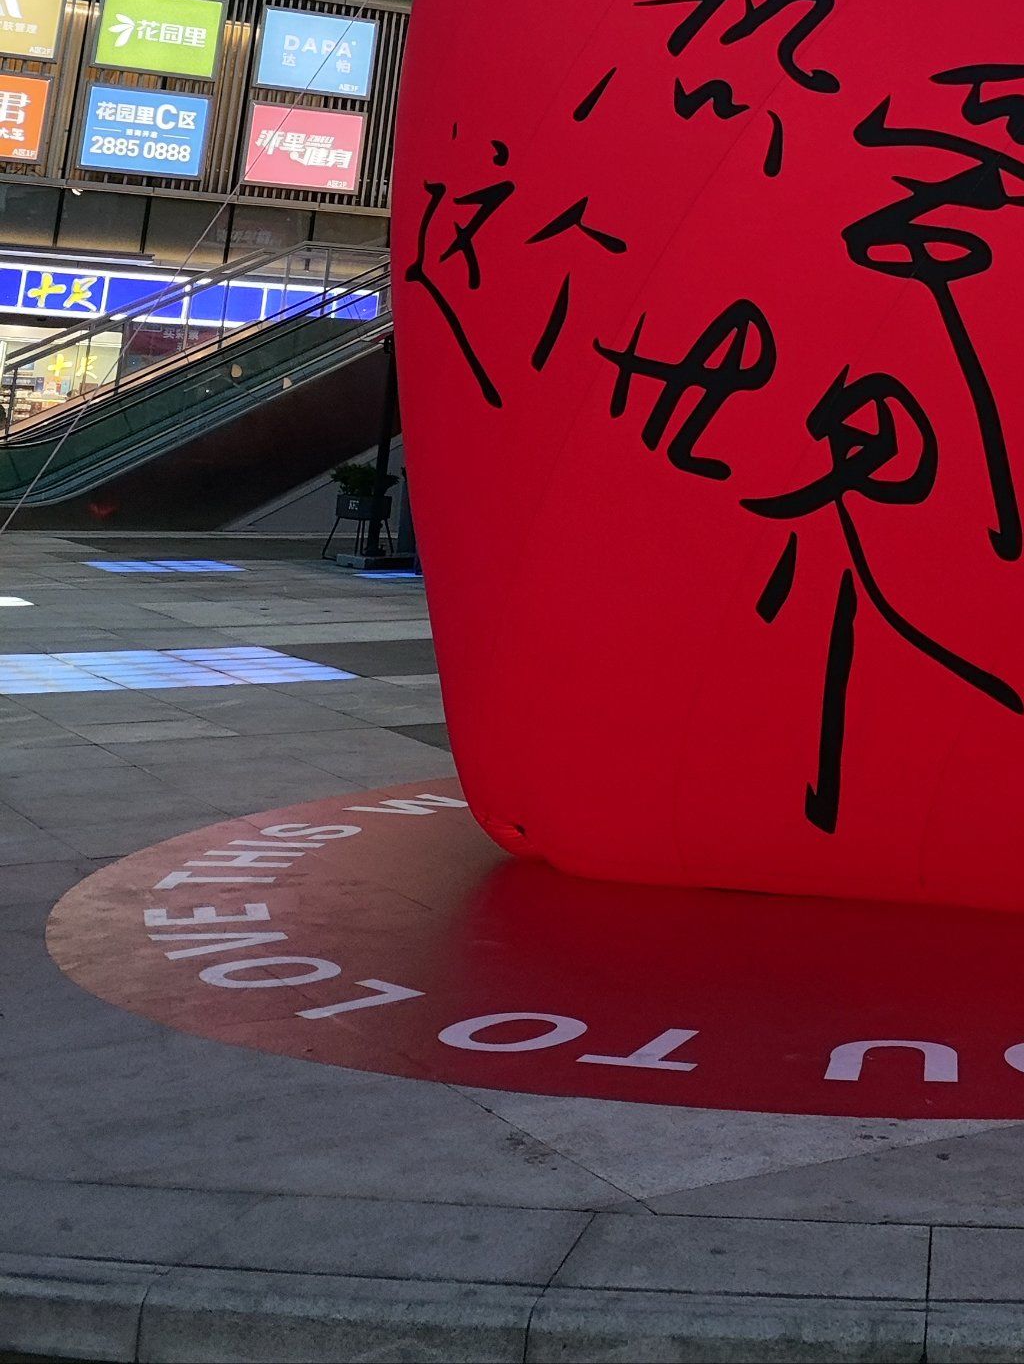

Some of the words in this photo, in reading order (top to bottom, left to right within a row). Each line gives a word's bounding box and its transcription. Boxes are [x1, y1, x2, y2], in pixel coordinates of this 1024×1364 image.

[137, 20, 207, 48] 花园里
[96, 101, 197, 130] 花园里C区
[90, 136, 140, 157] 2885
[143, 141, 191, 162] 0888
[152, 823, 363, 889] THIS
[144, 903, 427, 1020] LOVE
[438, 1012, 700, 1072] TO
